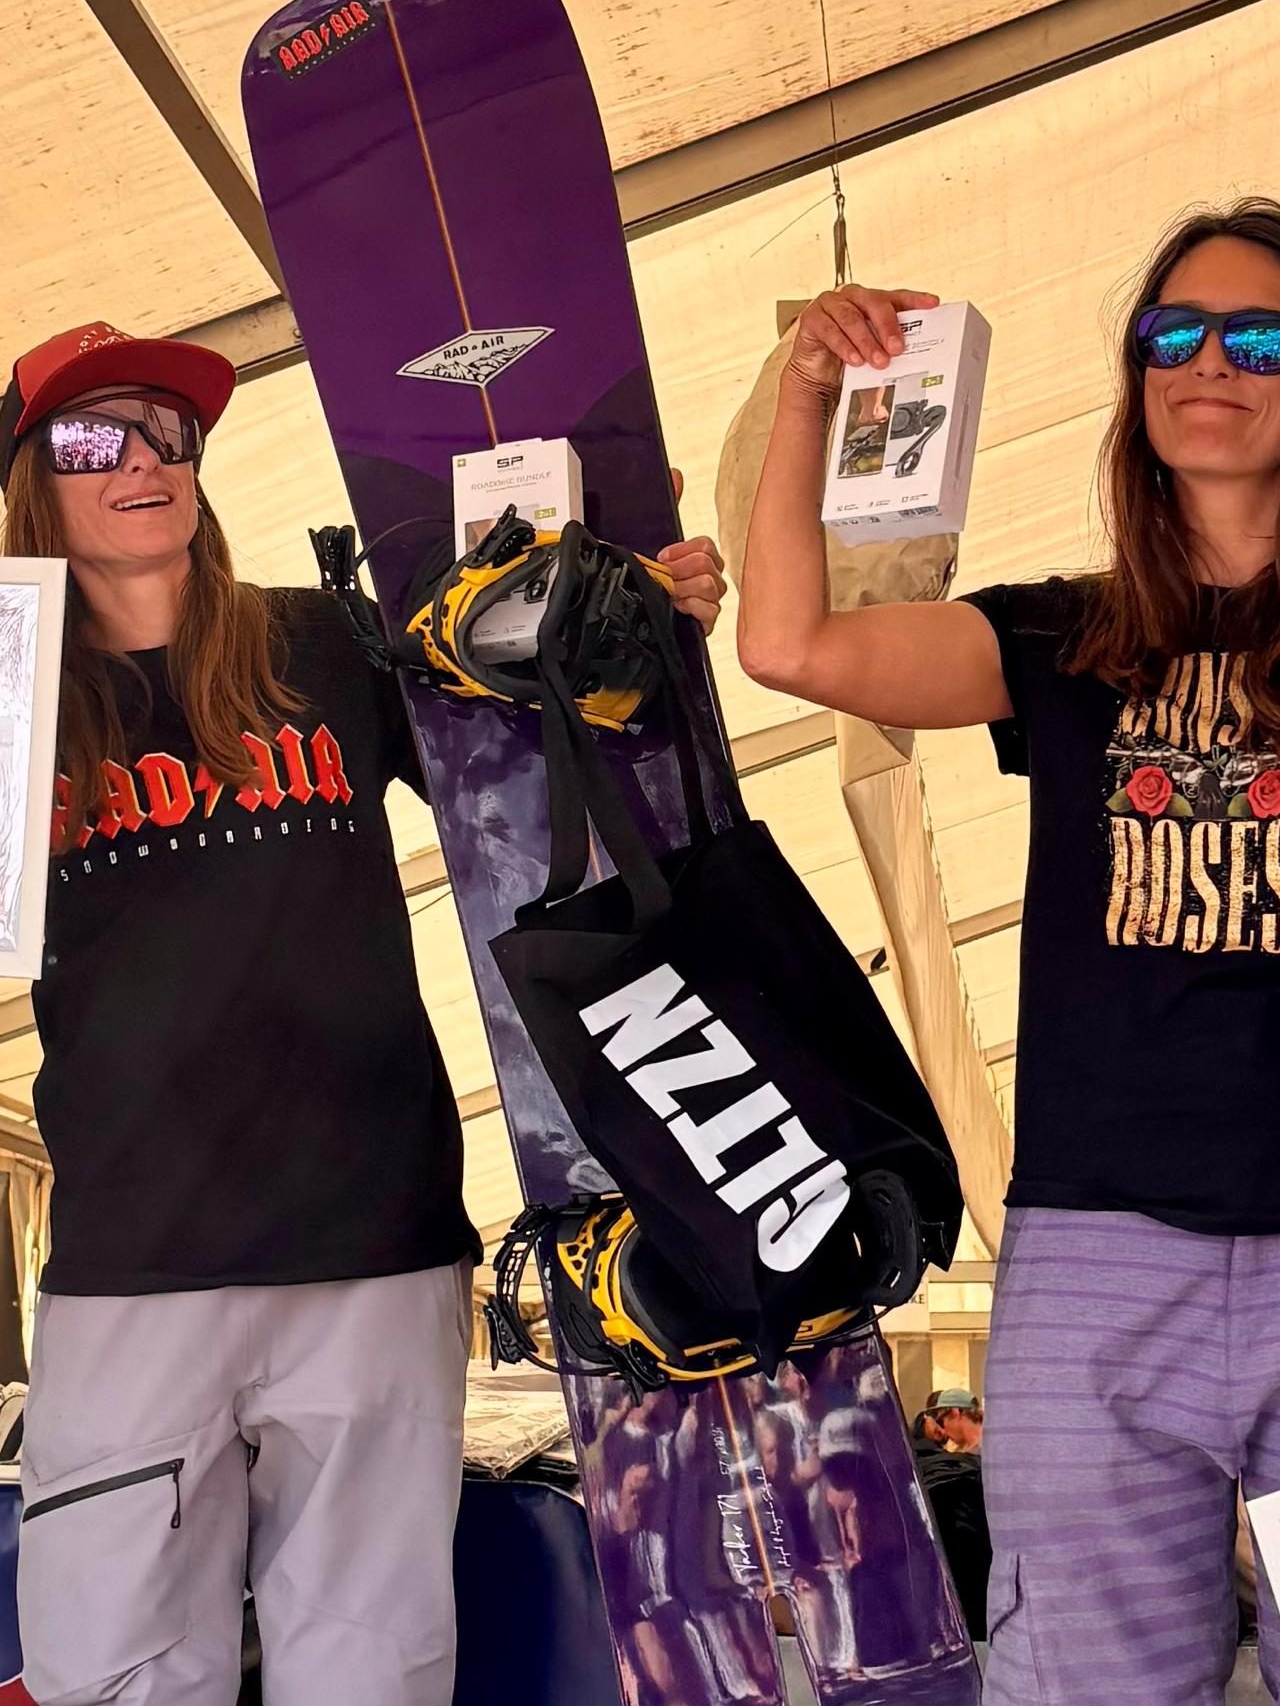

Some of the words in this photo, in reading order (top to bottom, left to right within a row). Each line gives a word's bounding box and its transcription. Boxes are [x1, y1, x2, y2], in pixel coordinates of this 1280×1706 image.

[443, 344, 469, 361] RAD
[481, 335, 505, 351] AIR
[497, 455, 524, 469] SP
